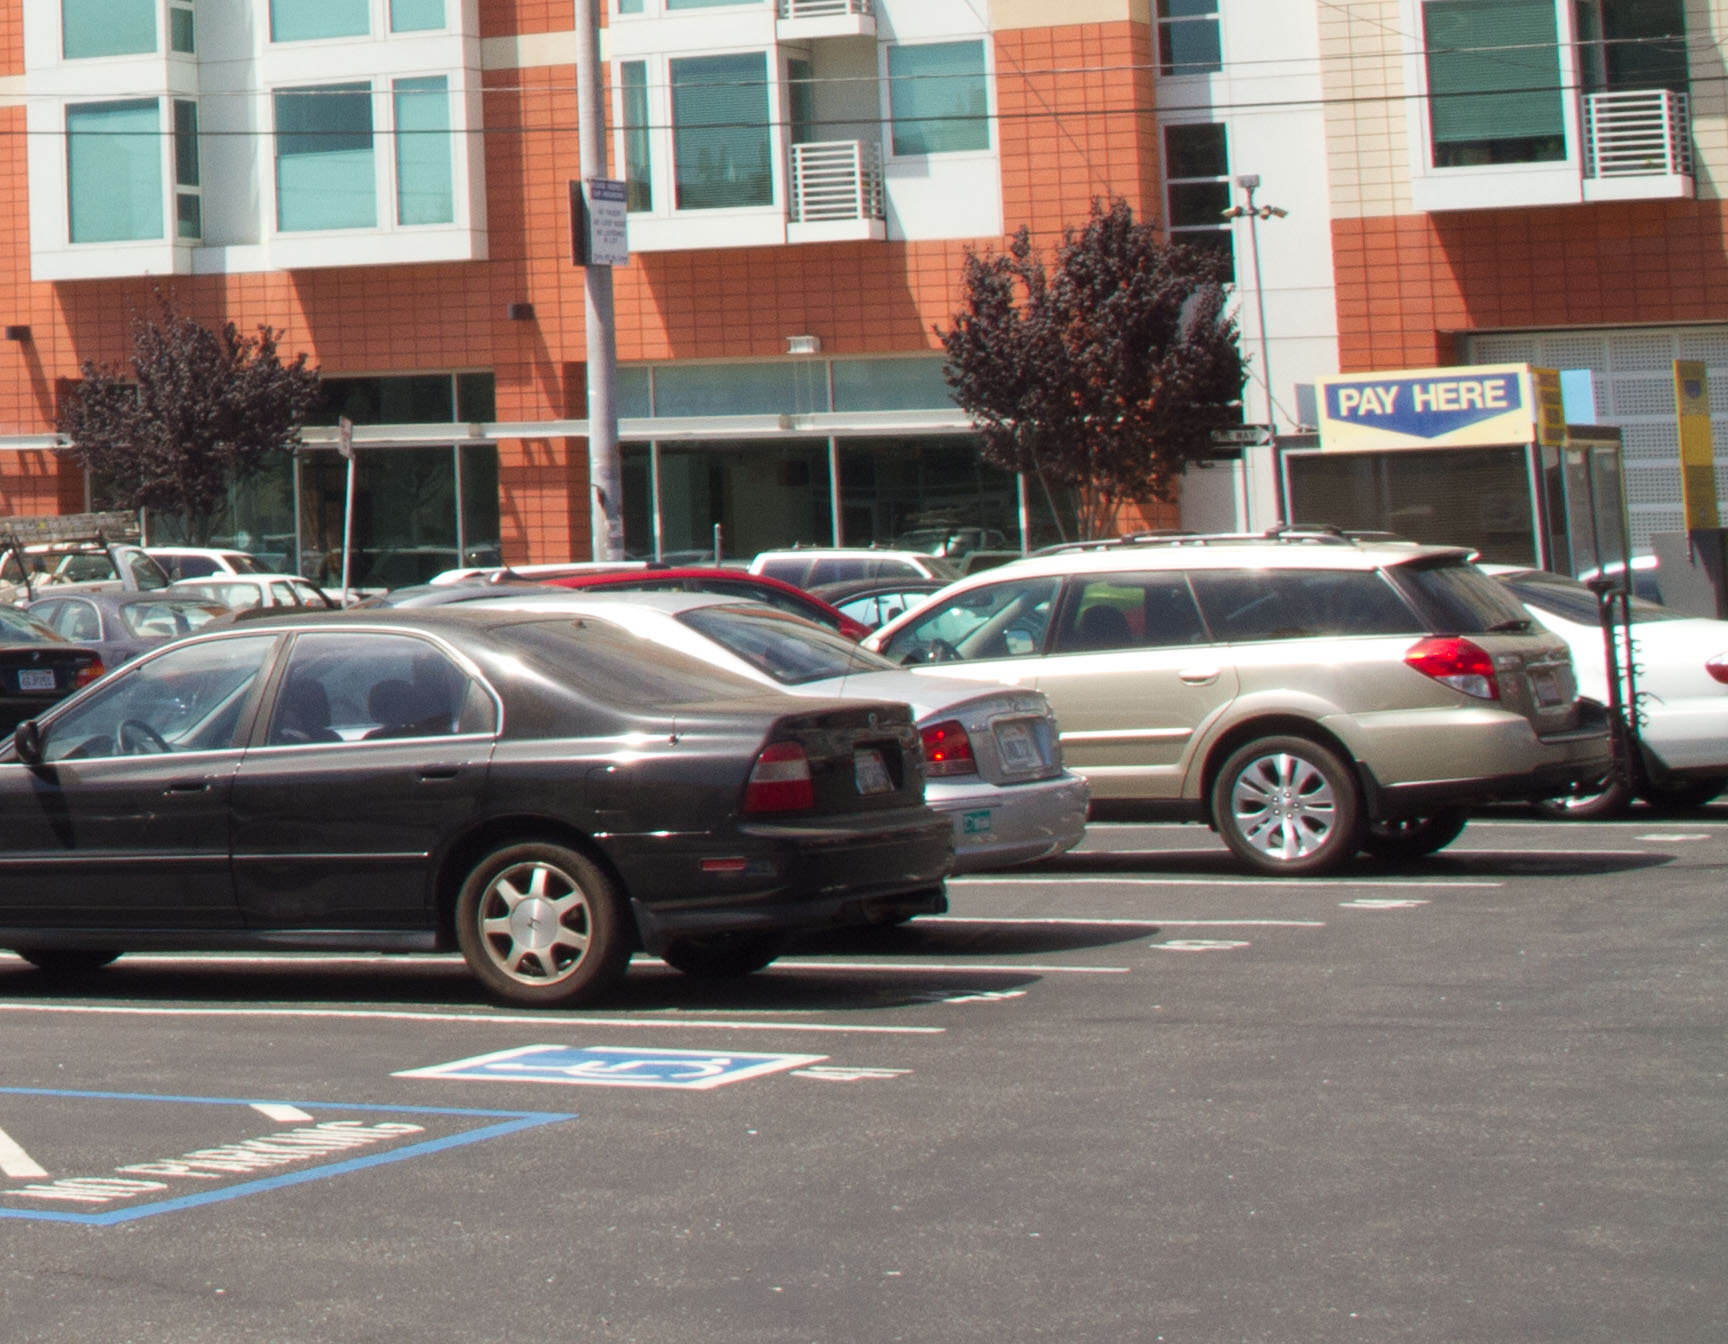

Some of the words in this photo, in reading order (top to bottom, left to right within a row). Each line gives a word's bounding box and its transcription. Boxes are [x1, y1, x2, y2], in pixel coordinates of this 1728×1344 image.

[1337, 386, 1401, 417] PAY
[1412, 379, 1509, 413] HERE
[0, 1177, 170, 1203] NO
[114, 1120, 427, 1180] PARKING
